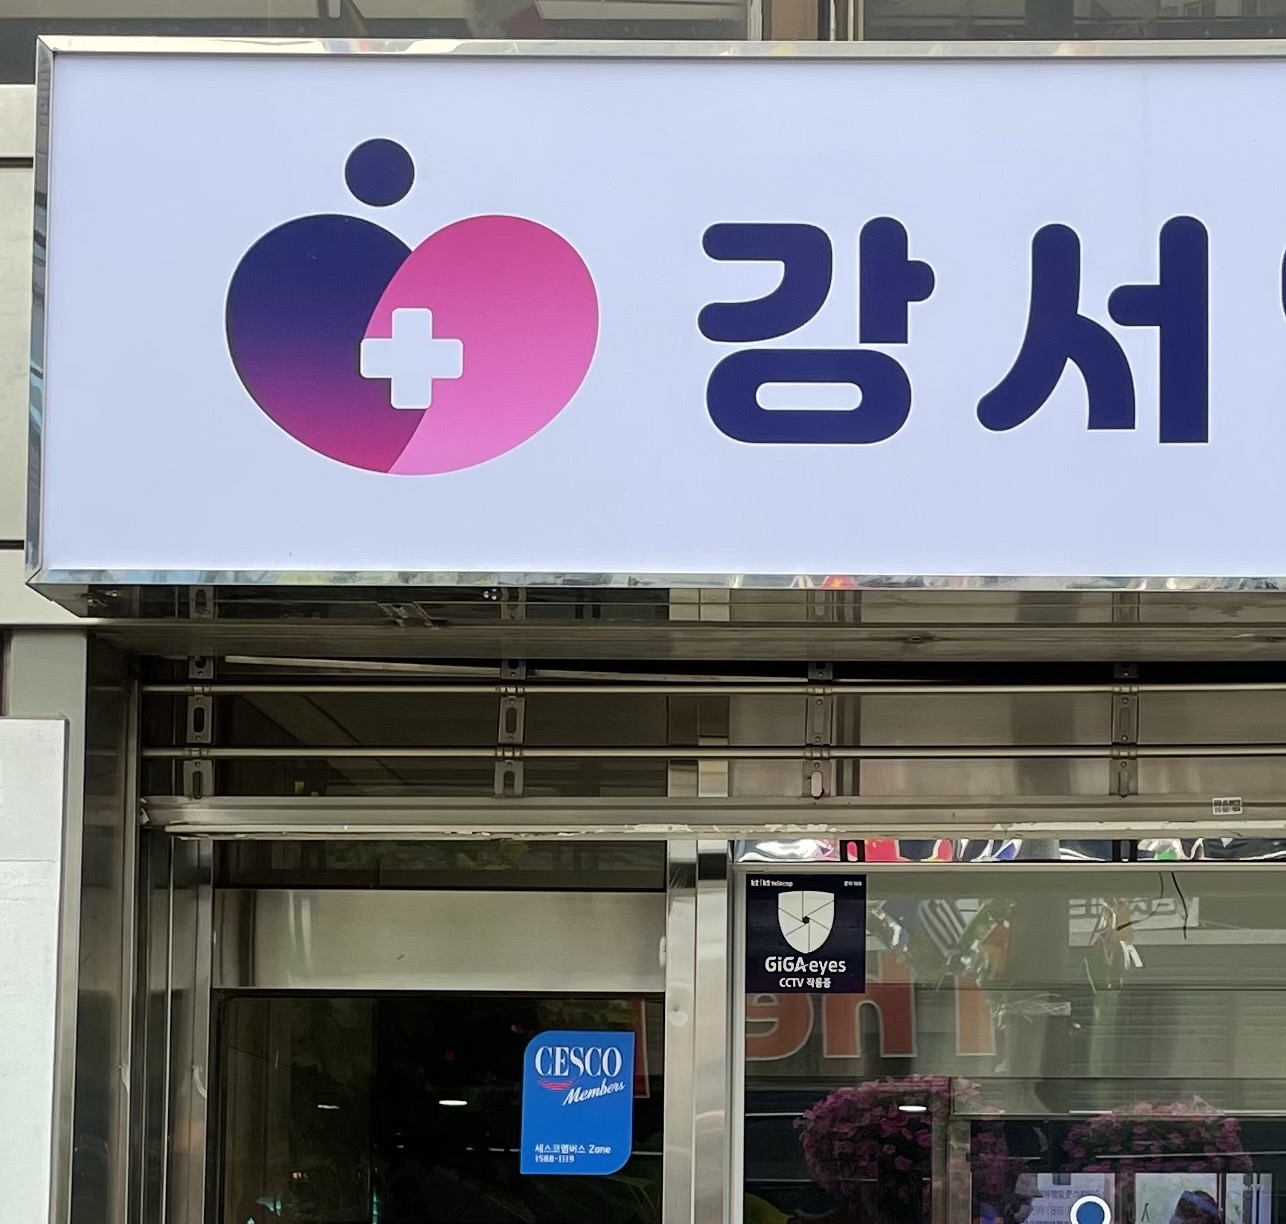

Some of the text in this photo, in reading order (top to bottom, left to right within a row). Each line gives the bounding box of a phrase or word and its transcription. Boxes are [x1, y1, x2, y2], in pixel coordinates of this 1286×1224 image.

[779, 977, 805, 988] CCTV
[534, 1046, 623, 1077] CESCO
[562, 1078, 626, 1106] Members
[588, 1144, 612, 1154] Zone
